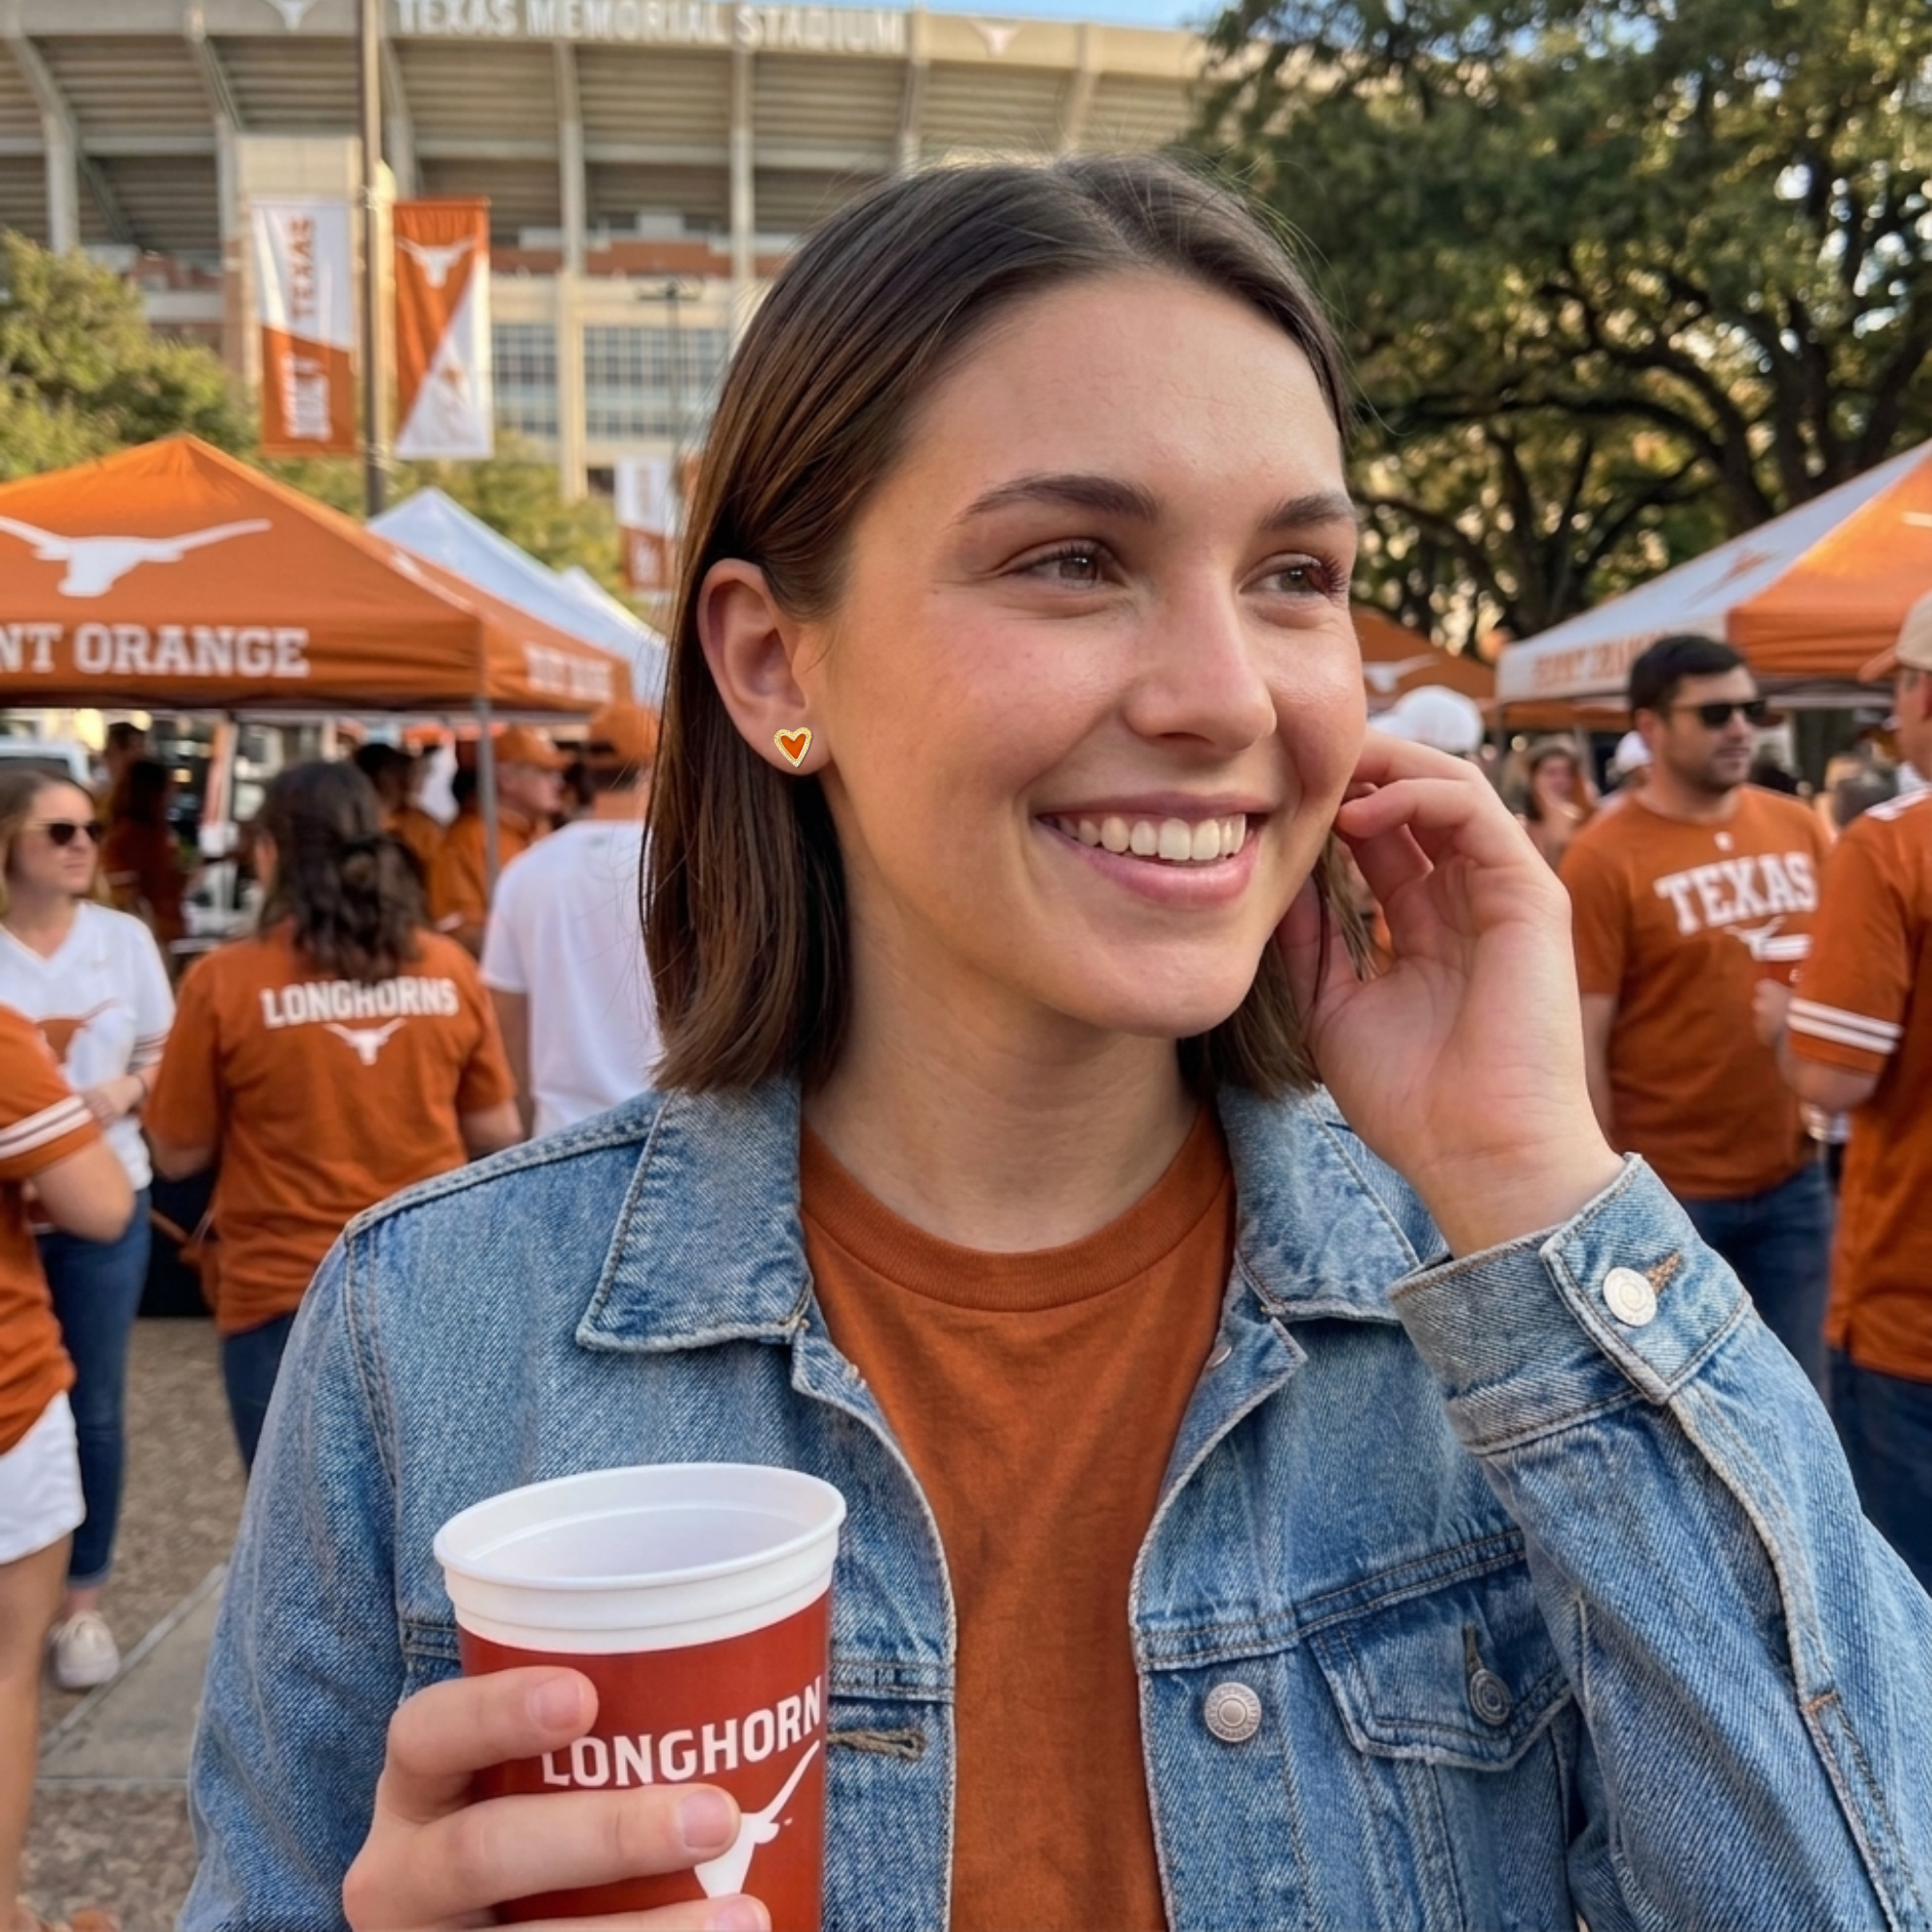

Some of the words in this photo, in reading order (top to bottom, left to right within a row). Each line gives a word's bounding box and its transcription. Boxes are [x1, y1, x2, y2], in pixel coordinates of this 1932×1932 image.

[398, 0, 519, 36] TEXAS
[289, 215, 316, 321] TEXAS
[73, 621, 311, 677] ORANGE
[1653, 850, 1819, 935] TEXAS
[259, 975, 460, 1029] LONGHORNS
[542, 1675, 821, 1787] LONGHORN
